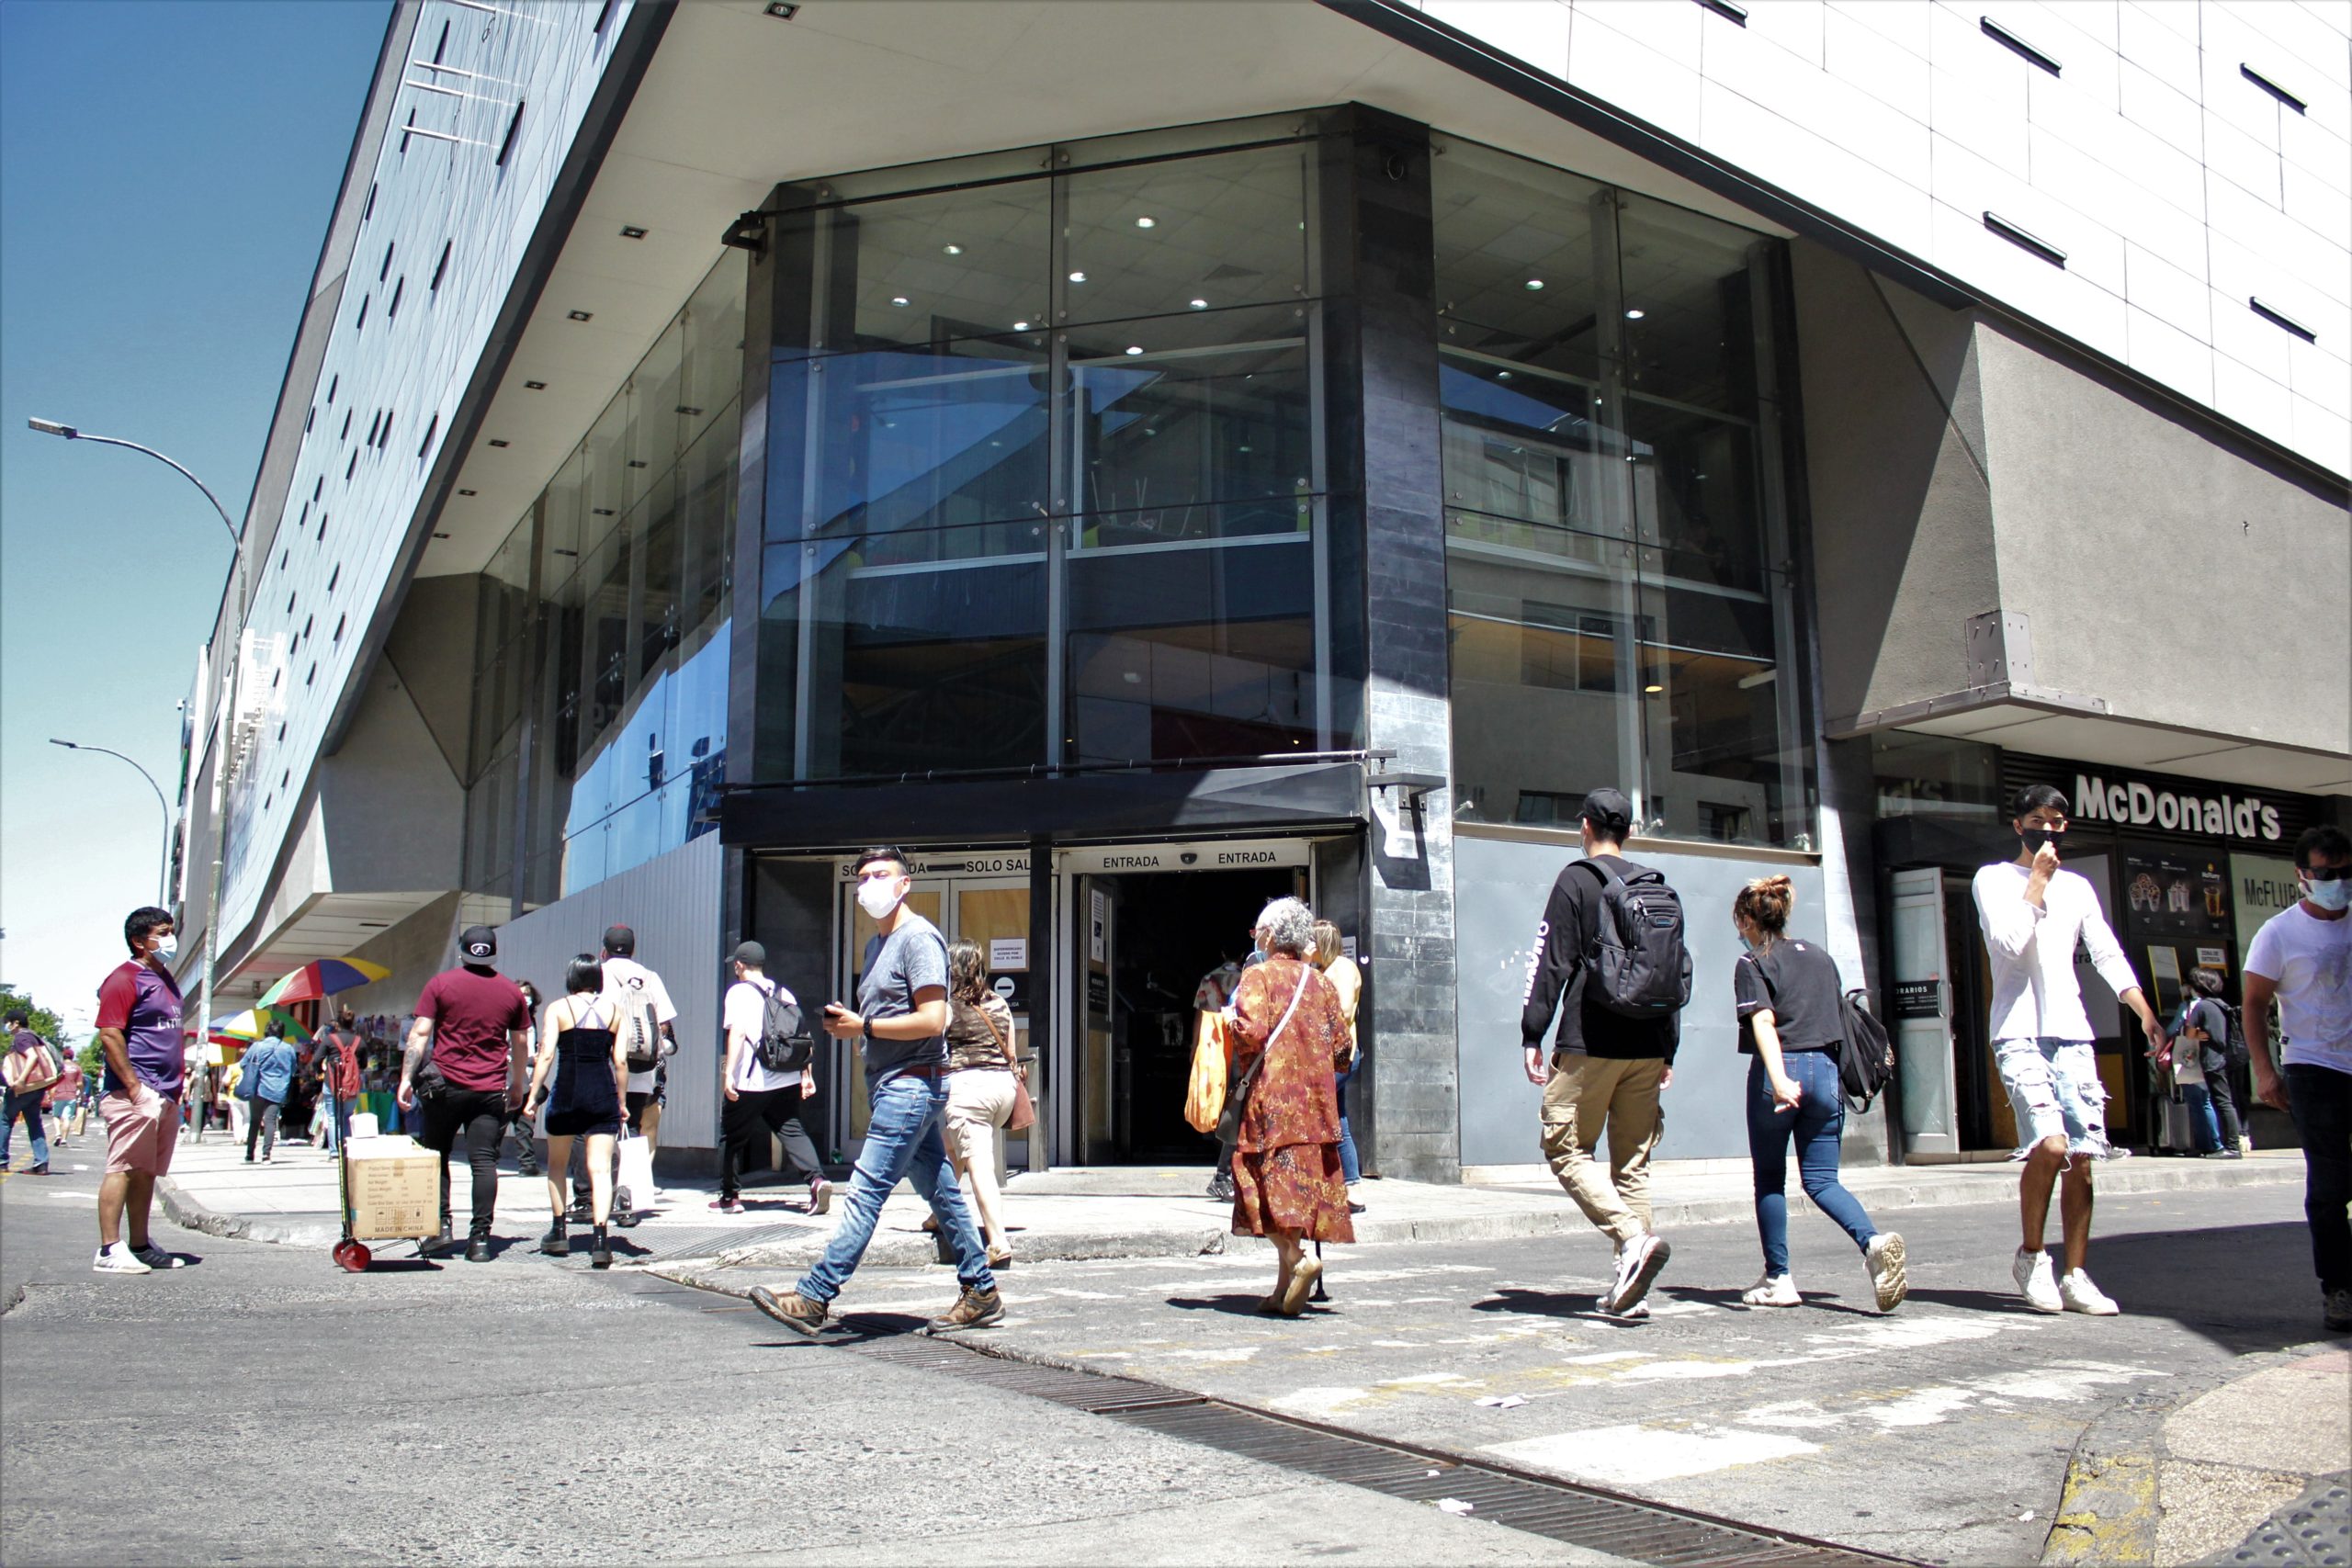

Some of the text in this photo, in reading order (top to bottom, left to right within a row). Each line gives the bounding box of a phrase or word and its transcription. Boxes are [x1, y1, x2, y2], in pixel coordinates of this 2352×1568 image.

[2075, 774, 2281, 840] McDonald's
[1103, 856, 1159, 868] ENTRADA
[1218, 852, 1276, 863] ENTRADA
[967, 860, 1002, 873] SOLO
[2244, 877, 2305, 909] McFLUR
